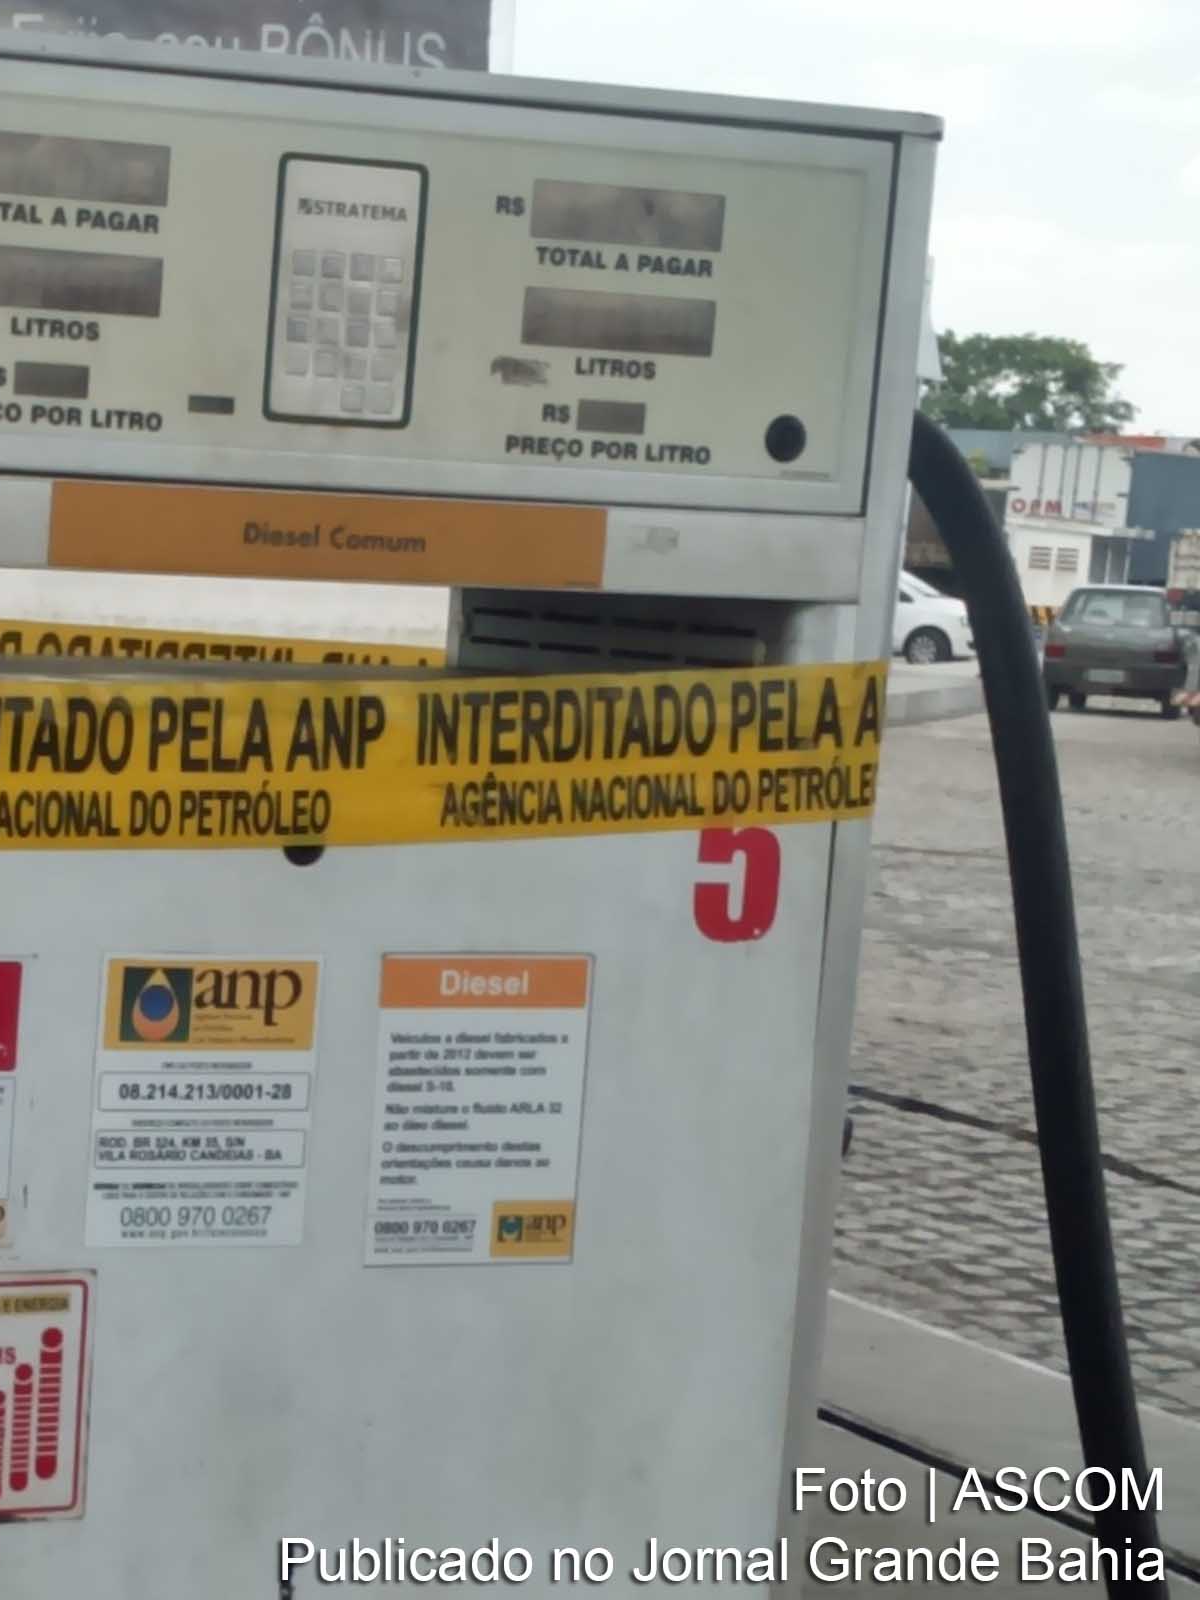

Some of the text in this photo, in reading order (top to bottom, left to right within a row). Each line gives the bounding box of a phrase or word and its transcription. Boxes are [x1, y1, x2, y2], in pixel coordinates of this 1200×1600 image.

[51, 207, 67, 226] A
[76, 209, 160, 233] PAGAR
[536, 246, 712, 277] TOTAL A PAGAR
[11, 316, 100, 341] LITROS
[575, 357, 657, 380] LITROS
[30, 405, 82, 426] POR
[90, 408, 162, 431] LITRO
[506, 435, 711, 464] PREÇO POR LITRO
[243, 522, 427, 552] Diesel Comum
[149, 696, 273, 773] PELA
[287, 696, 386, 773] ANP
[417, 681, 717, 767] INTERDITADO
[730, 678, 843, 755] PELA
[440, 755, 878, 828] AGÊNCIA NACIONAL DO PETRÓLE
[130, 789, 172, 837] DO
[180, 780, 332, 836] PETRÓLEO
[692, 826, 782, 943] 5
[439, 969, 529, 996] Diesel
[195, 968, 303, 1027] anp
[118, 1083, 293, 1100] 08.214.213/0001-28
[119, 1205, 273, 1227] 0800 970 0267
